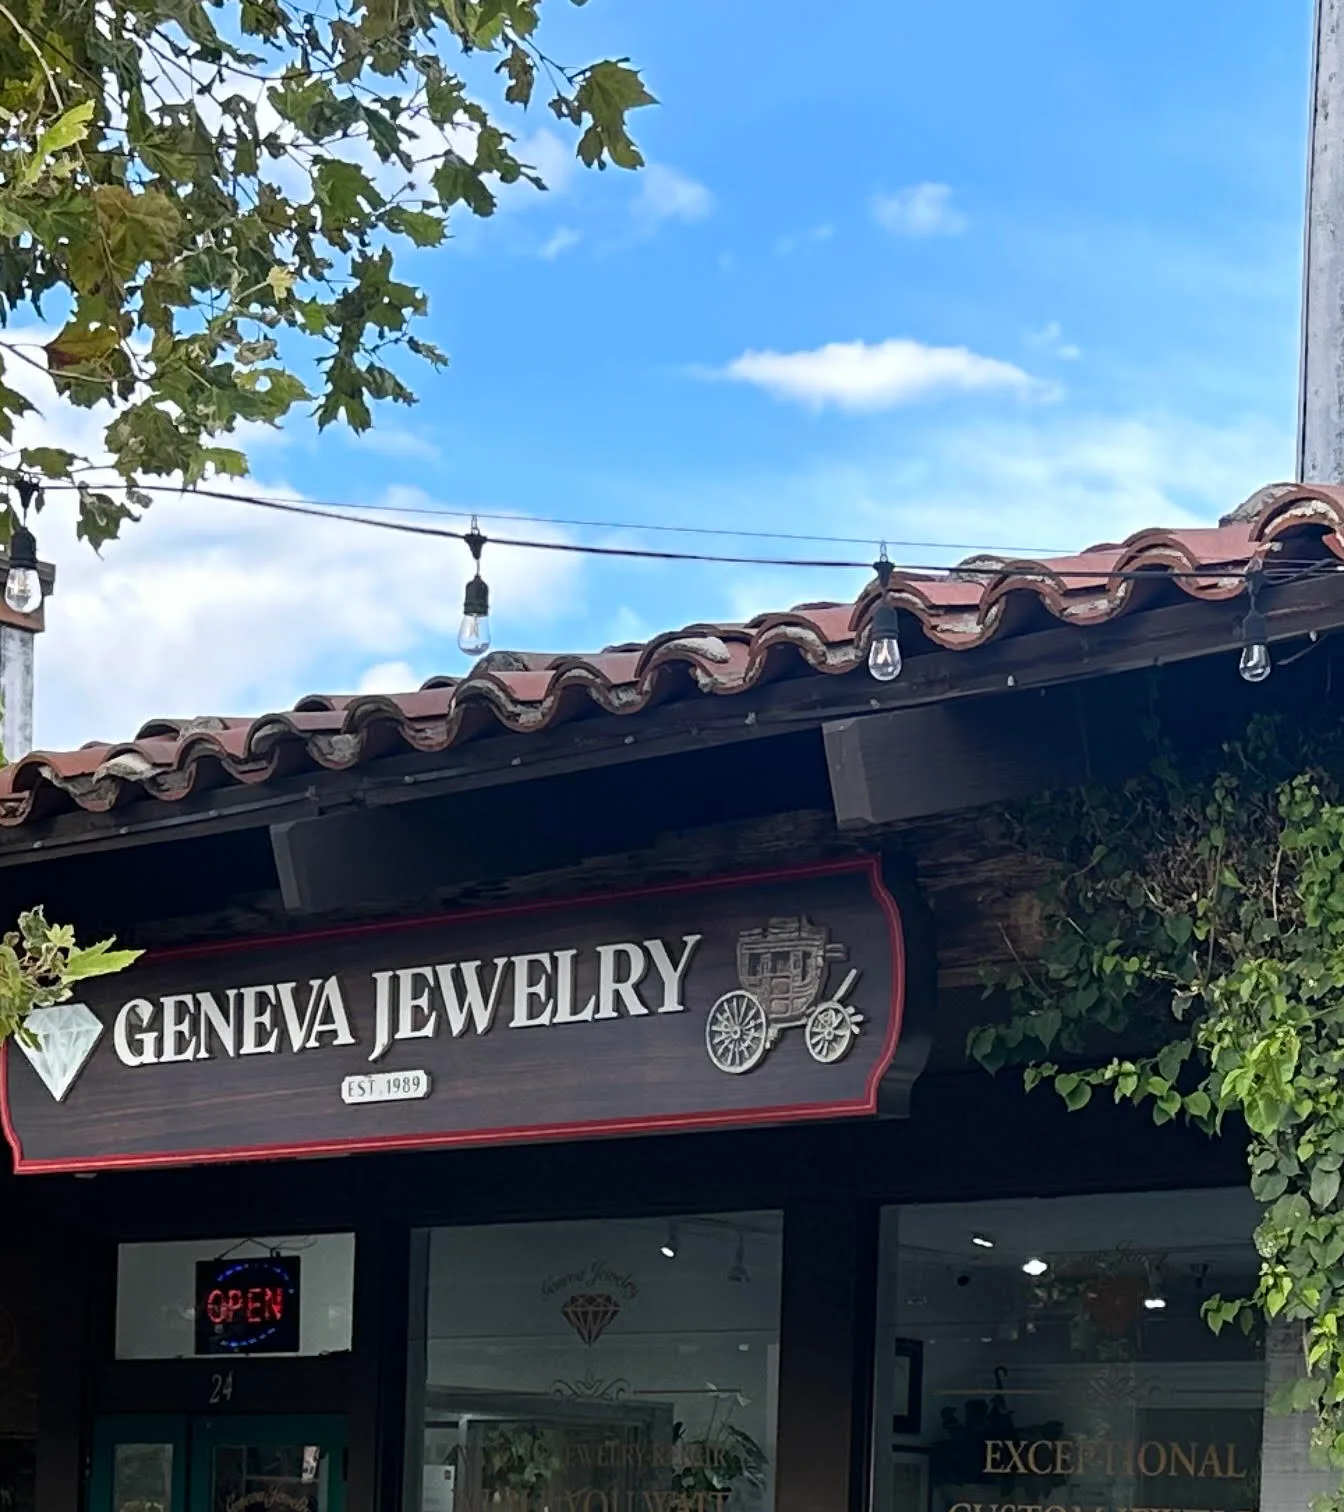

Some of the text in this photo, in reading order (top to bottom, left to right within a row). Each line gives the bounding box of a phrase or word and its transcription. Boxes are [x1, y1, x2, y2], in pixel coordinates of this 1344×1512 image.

[114, 934, 703, 1067] GENEVA JEWELRY
[348, 1075, 421, 1098] EST. 1989
[207, 1287, 284, 1324] OPEN
[209, 1368, 234, 1405] 24
[983, 1438, 1246, 1478] EXCEPTIONAL
